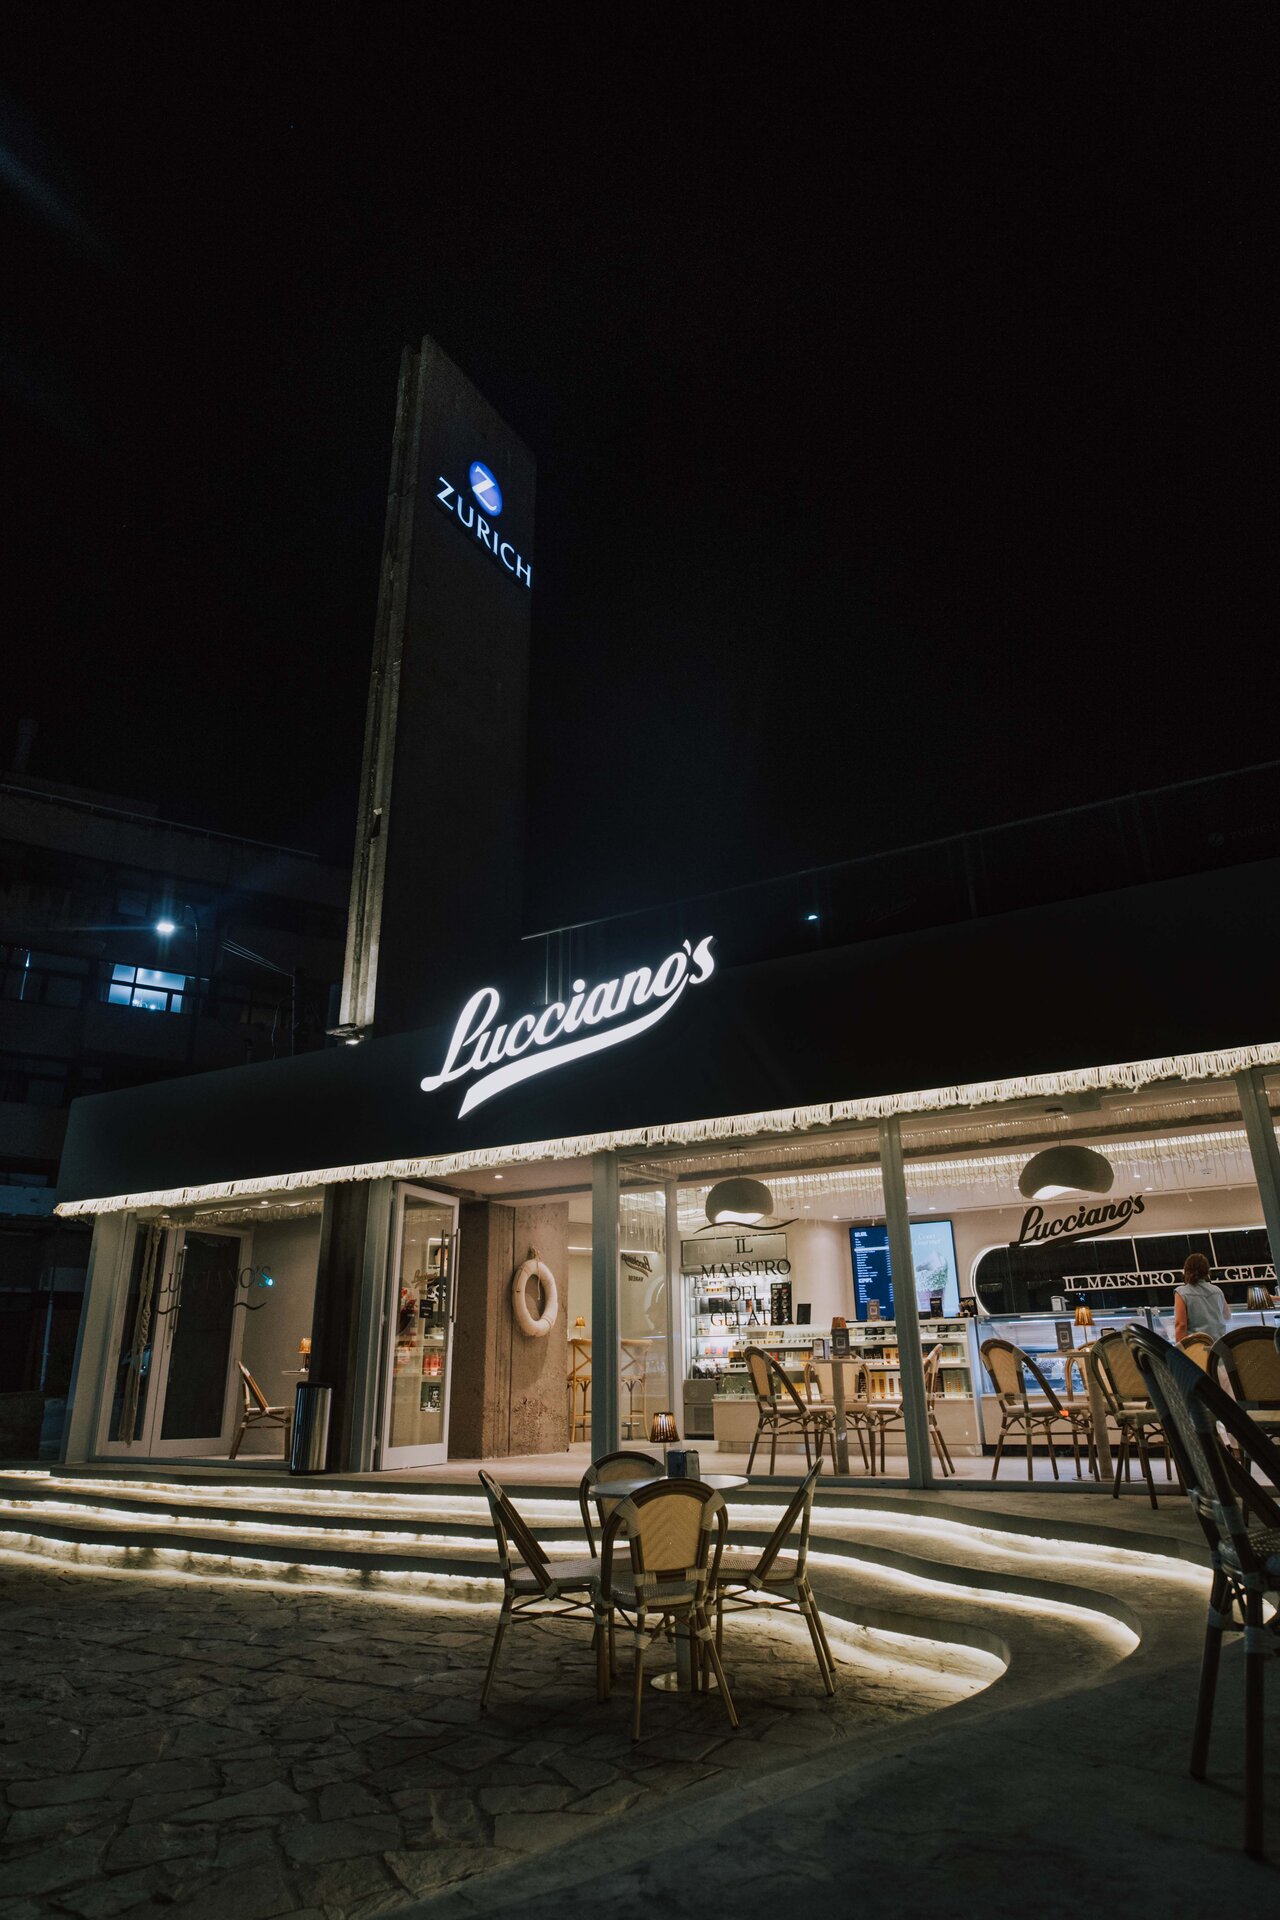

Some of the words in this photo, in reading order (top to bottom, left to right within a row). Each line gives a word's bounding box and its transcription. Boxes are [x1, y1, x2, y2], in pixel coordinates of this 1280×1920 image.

[436, 476, 532, 588] ZURICH
[420, 935, 716, 1093] Lucciano's
[1009, 1194, 1146, 1247] Lucciano's
[735, 1238, 753, 1254] IL
[701, 1258, 791, 1280] MAESTRO
[1065, 1277, 1083, 1290] IL
[1087, 1271, 1175, 1289] MAESTRO
[729, 1285, 764, 1302] DEL
[711, 1308, 772, 1327] GELAT
